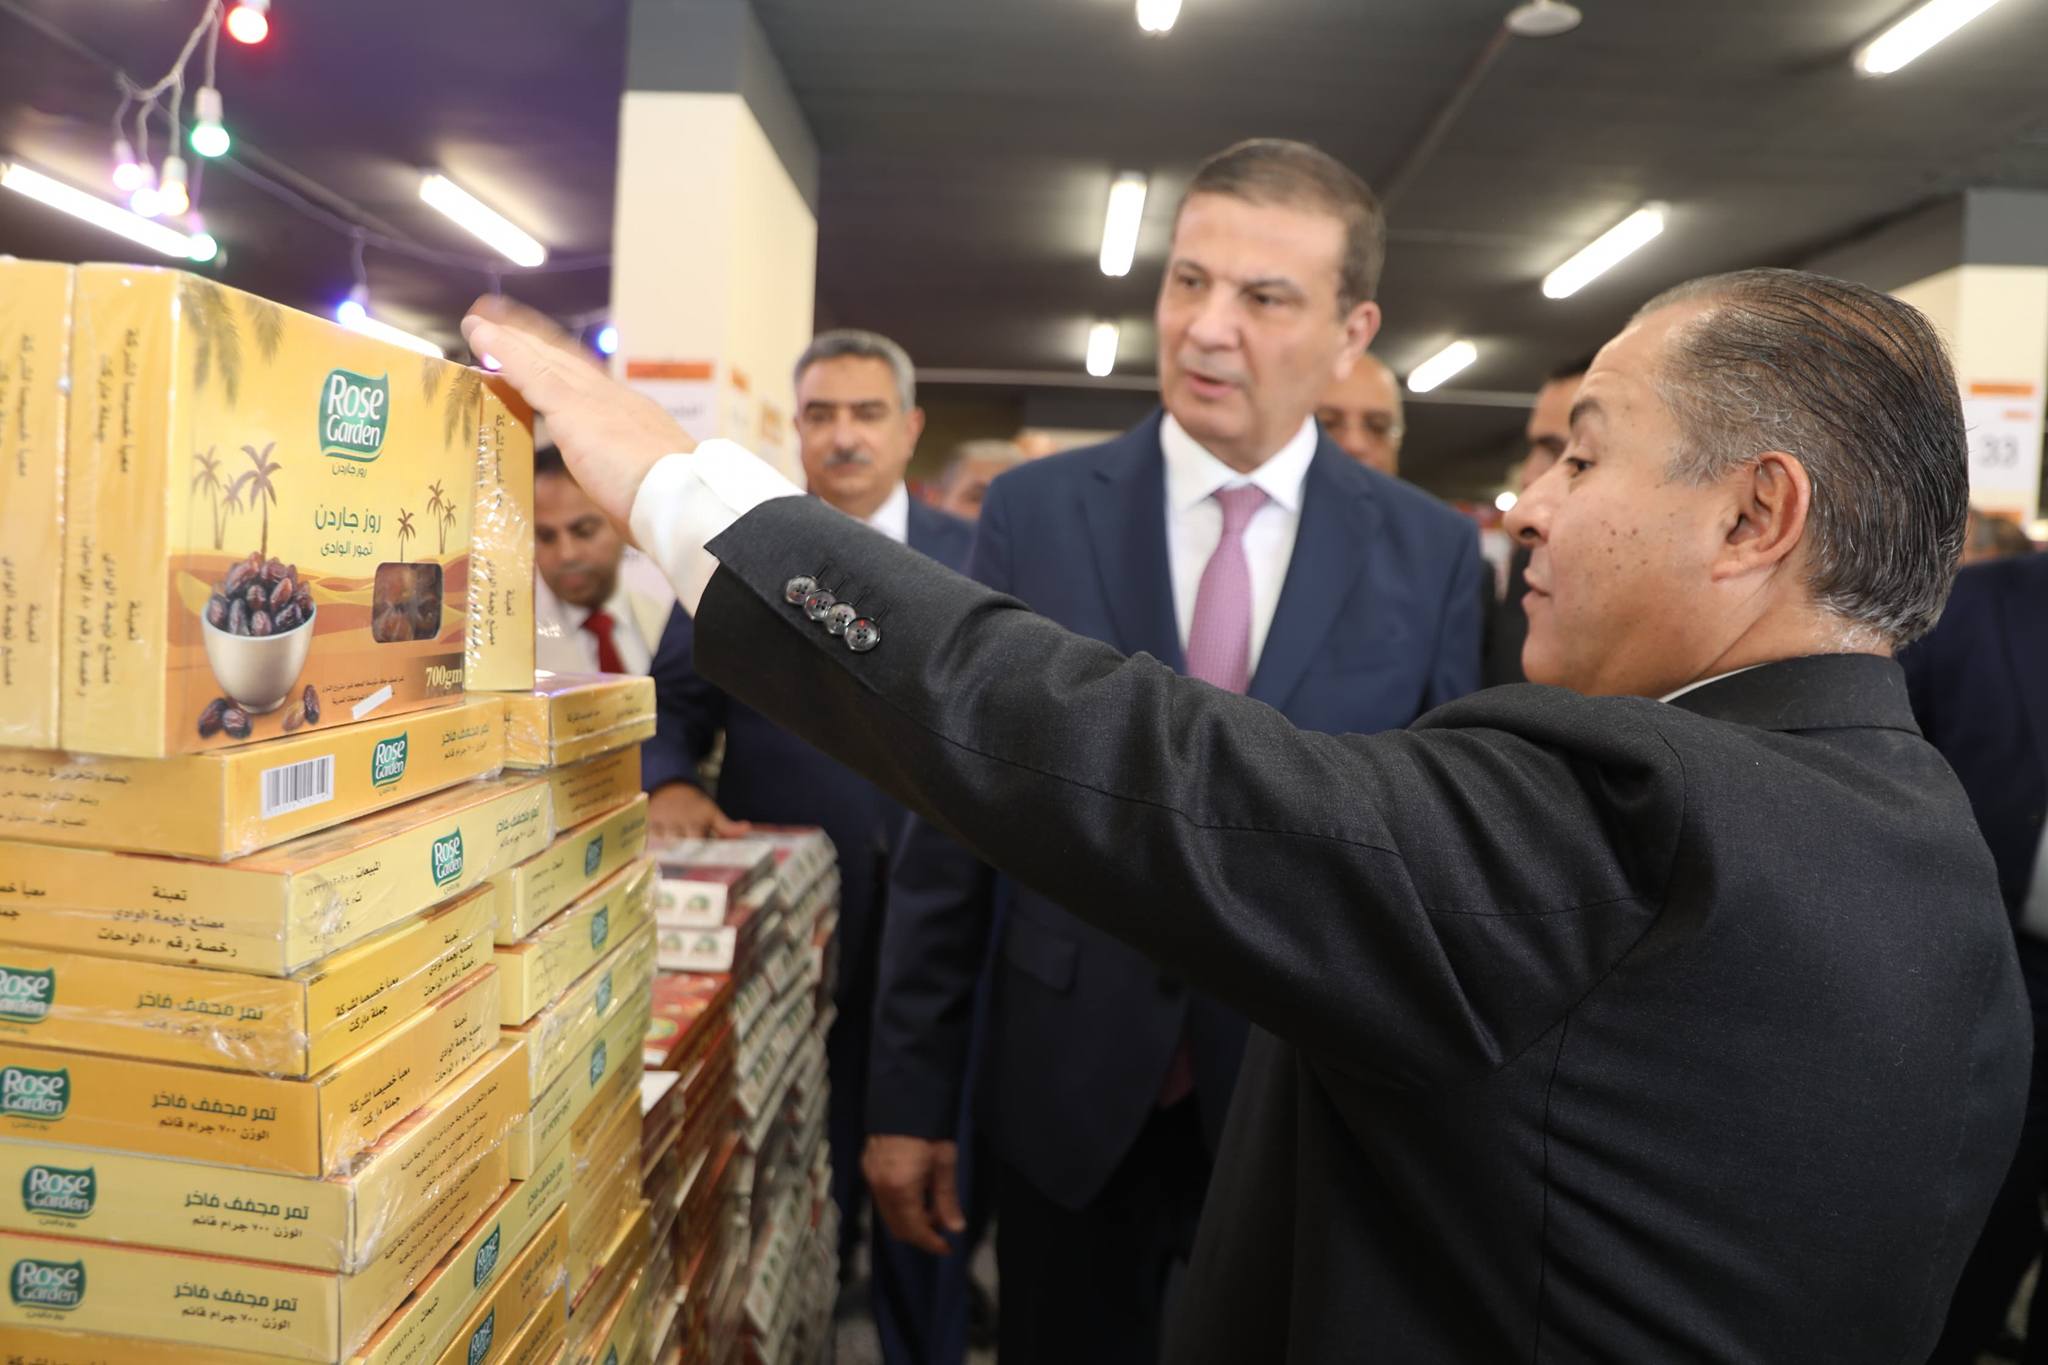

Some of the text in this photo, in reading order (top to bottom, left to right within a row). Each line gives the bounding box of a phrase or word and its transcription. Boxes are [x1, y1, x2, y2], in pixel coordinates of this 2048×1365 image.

[327, 374, 384, 420] Rose
[327, 414, 381, 447] Garden
[315, 503, 382, 534] روز جاردن
[352, 541, 373, 556] تمور
[425, 664, 463, 690] 700gm
[375, 739, 406, 767] Rose
[375, 759, 405, 780] Garden
[434, 836, 461, 864] Rose
[436, 857, 462, 880] Garden
[154, 909, 186, 928] نجمة
[190, 916, 225, 931] مصنع
[97, 927, 145, 947] الواحات
[166, 936, 191, 953] رقم
[195, 938, 238, 957] رخصة
[136, 991, 173, 1010] فاخر
[3, 1069, 65, 1097] Rose
[3, 1094, 63, 1114] Garden
[151, 1091, 278, 1122] تمر مجفف فاخر
[187, 1121, 216, 1136] جرام
[240, 1129, 271, 1142] الوزن
[30, 1167, 90, 1196] Rose
[30, 1191, 89, 1213] Garden
[184, 1190, 311, 1221] تمر مجفف فاخر
[219, 1219, 249, 1233] جرام
[273, 1228, 303, 1240] الوزن
[18, 1261, 80, 1289] Rose
[18, 1284, 79, 1304] Garden
[173, 1281, 299, 1313] تمر مجفف فاخر
[209, 1310, 238, 1325] جرام
[262, 1319, 291, 1331] الوزن
